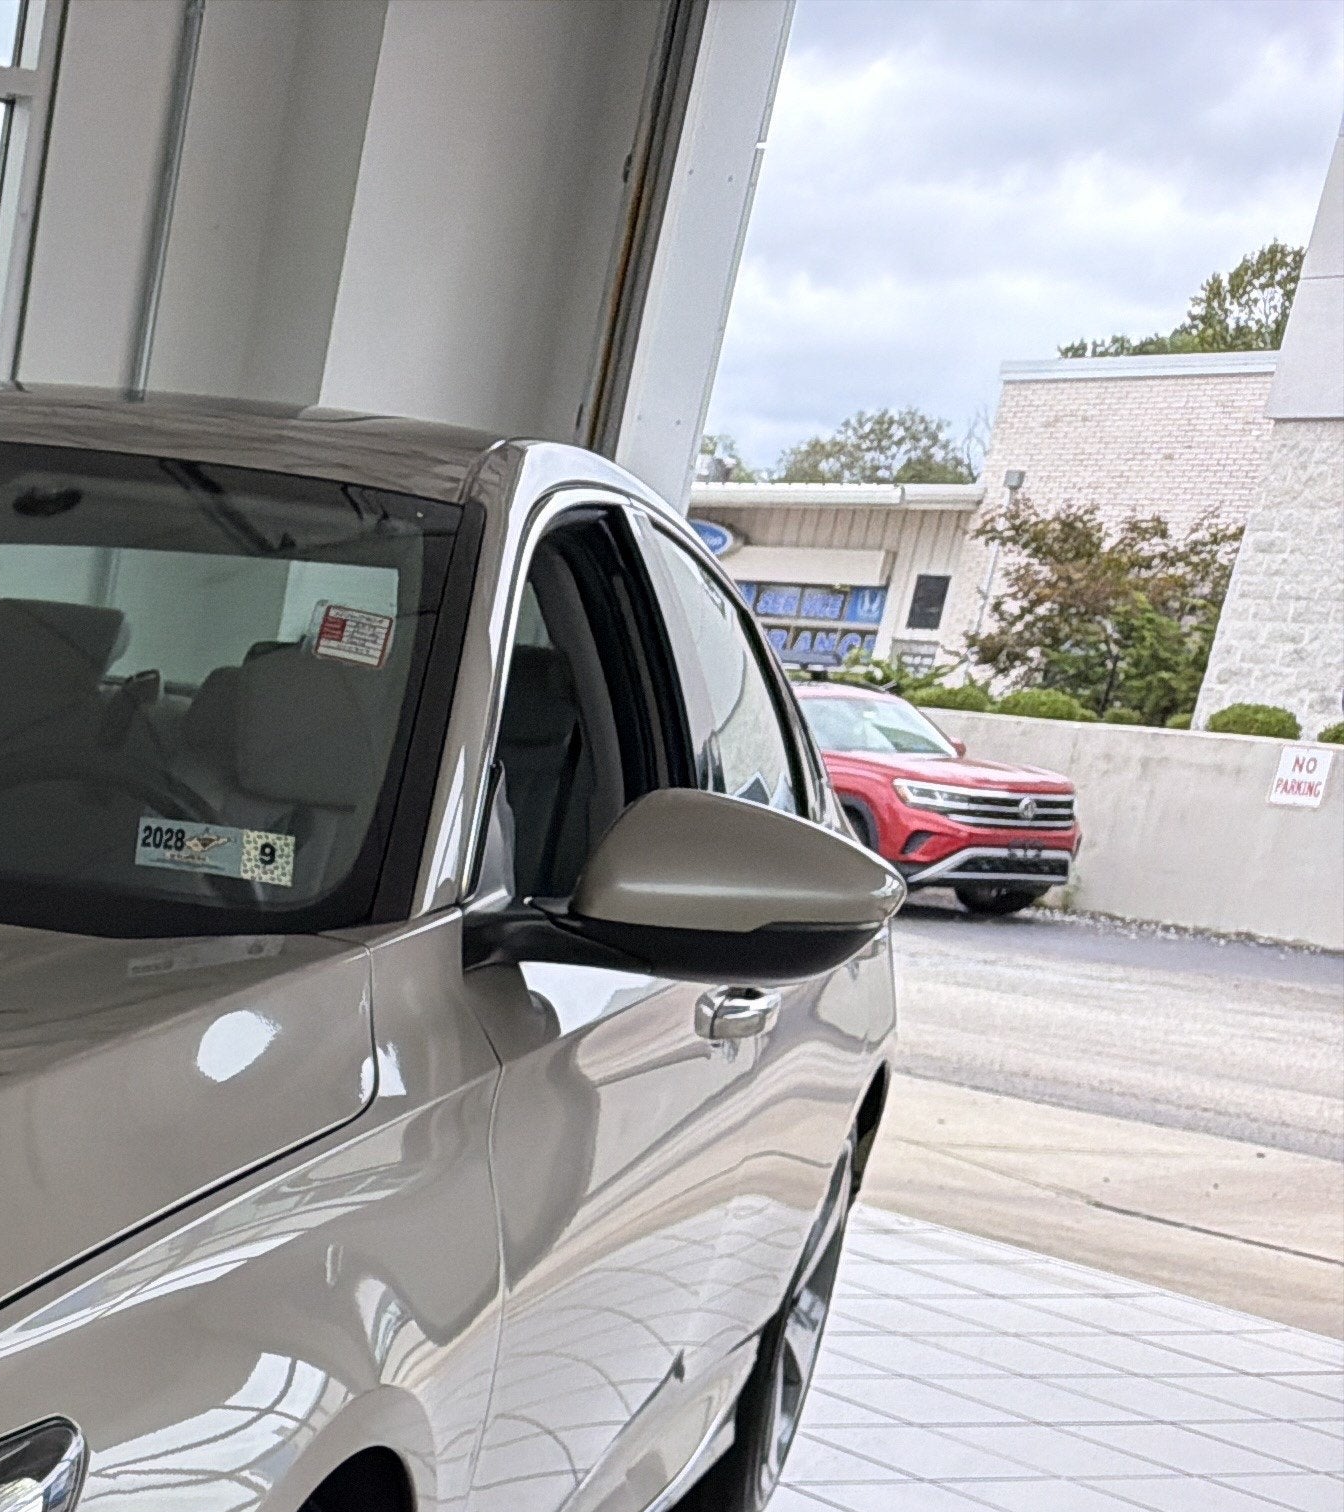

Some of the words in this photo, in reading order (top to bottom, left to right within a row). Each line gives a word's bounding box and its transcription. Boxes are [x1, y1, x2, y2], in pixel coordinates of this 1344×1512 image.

[1292, 755, 1317, 774] NO
[1275, 778, 1322, 797] PARKING
[140, 825, 186, 851] 2028
[259, 842, 276, 866] 9
